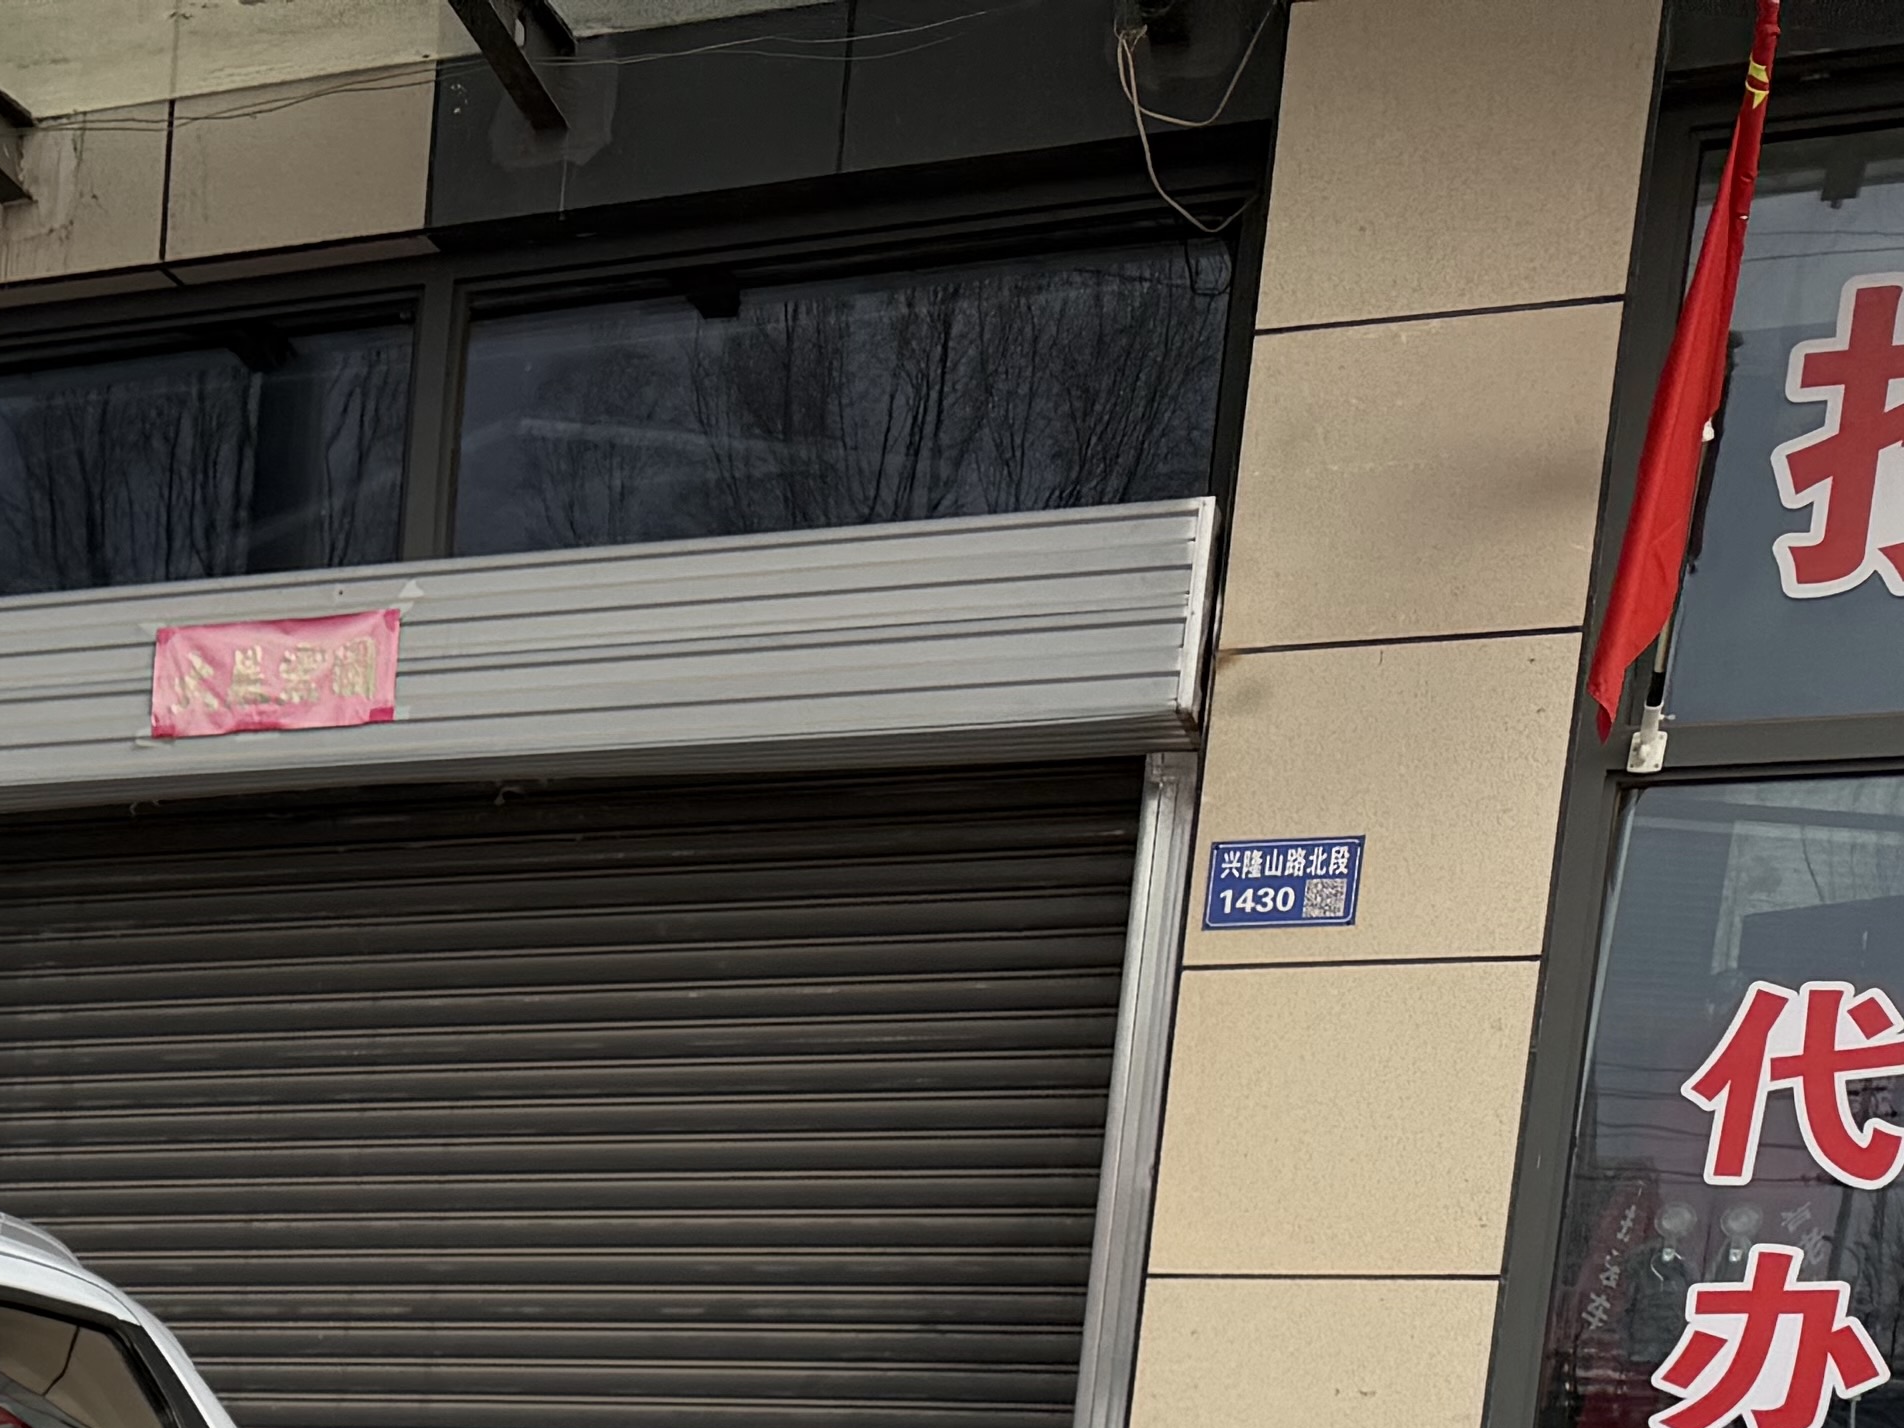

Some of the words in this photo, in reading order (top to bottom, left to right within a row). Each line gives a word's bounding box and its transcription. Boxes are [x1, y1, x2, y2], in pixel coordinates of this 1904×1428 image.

[1220, 846, 1350, 879] 兴隆山路北段
[1219, 886, 1295, 914] 1430
